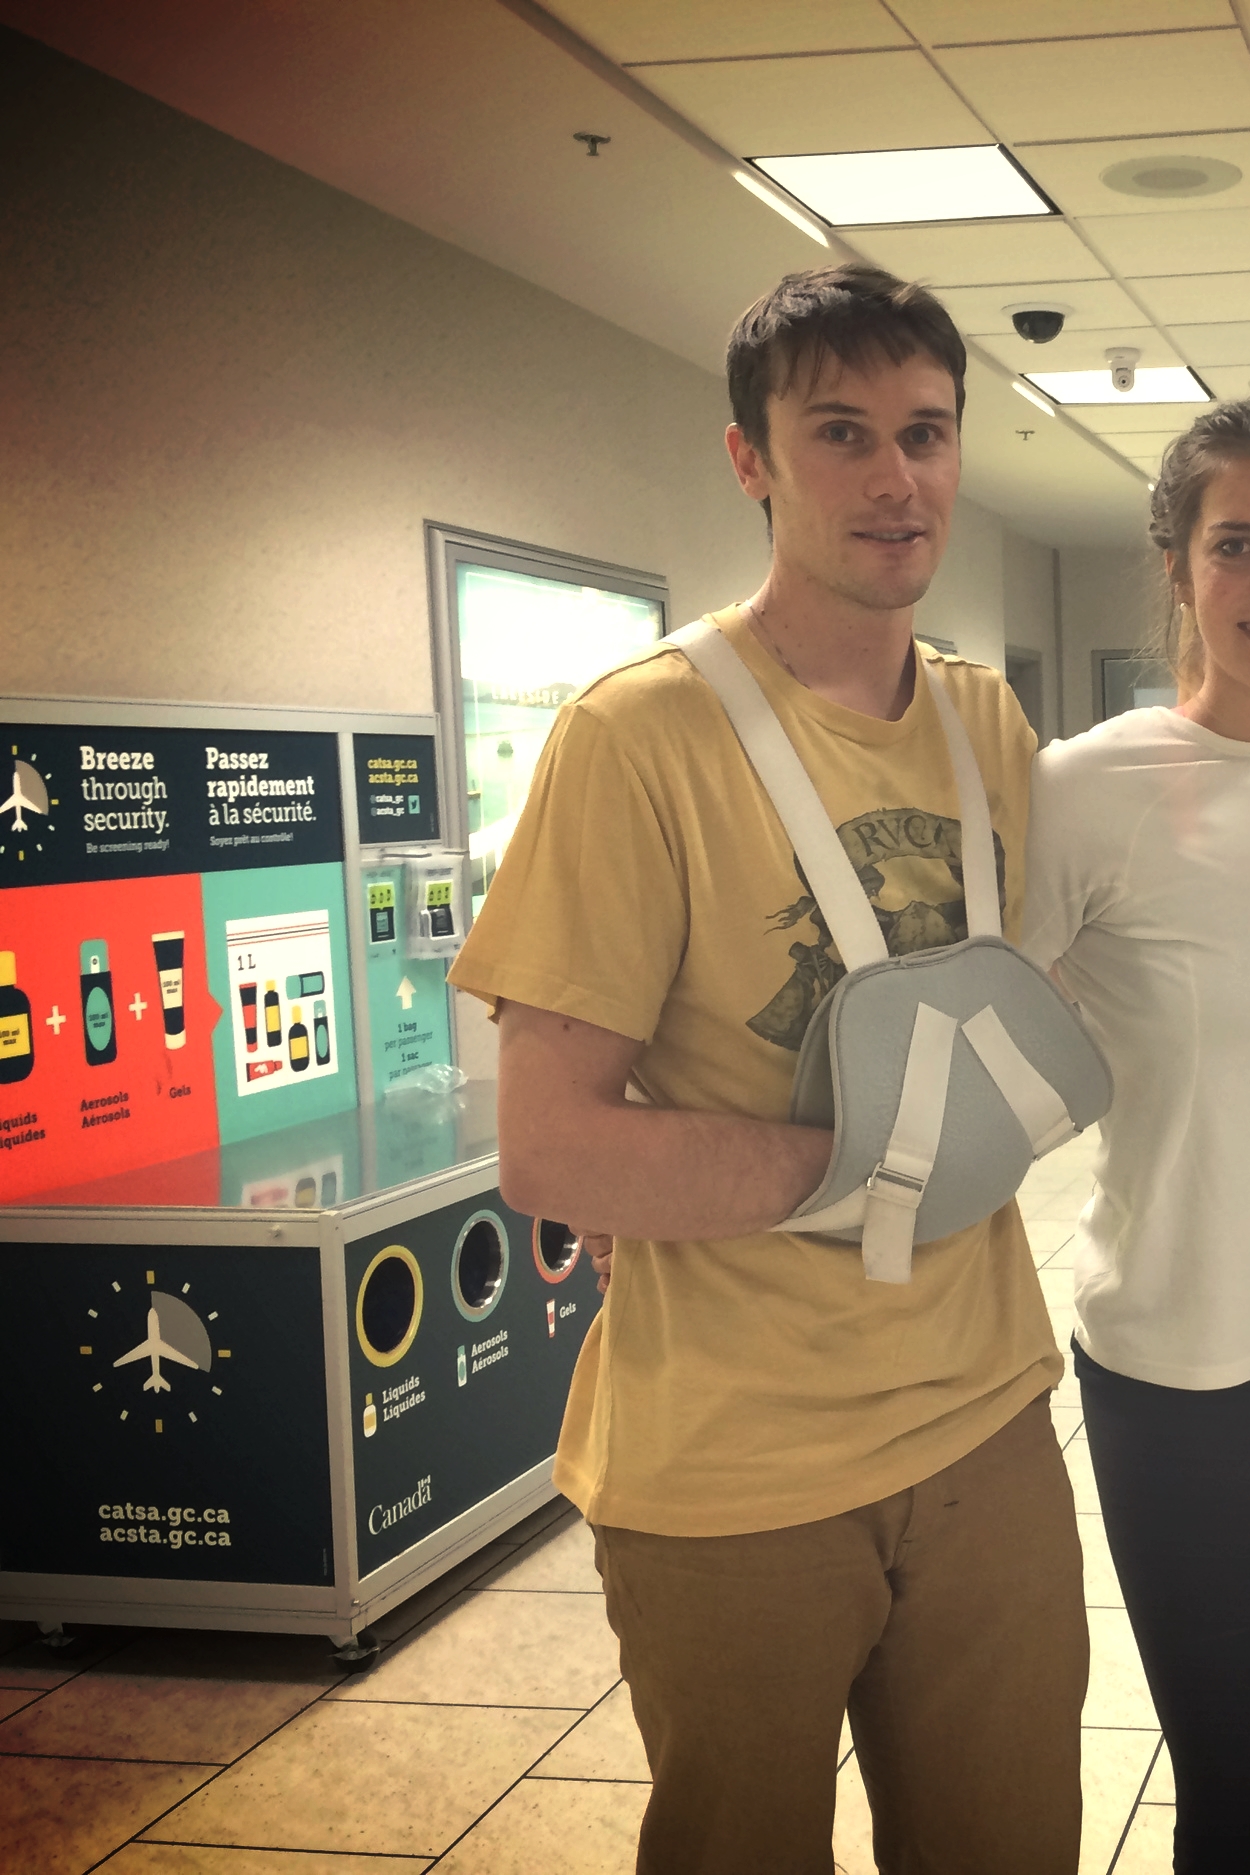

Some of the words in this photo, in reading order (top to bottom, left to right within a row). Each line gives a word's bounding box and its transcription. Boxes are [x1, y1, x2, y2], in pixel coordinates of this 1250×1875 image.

[79, 745, 155, 771] Breeze
[205, 747, 269, 770] Passez
[367, 757, 418, 773] catsa.gc.ca
[80, 775, 168, 806] through
[206, 775, 315, 803] rapidement
[368, 771, 419, 787] acsta.gc.ca
[83, 805, 170, 835] security.
[209, 803, 220, 826] à
[223, 803, 240, 826] la
[243, 800, 317, 825] sécurité.
[247, 953, 256, 969] L
[80, 1091, 129, 1112] Aerosols
[169, 1084, 191, 1099] Gels
[81, 1107, 131, 1129] Aérosols
[0, 1128, 46, 1151] iquides
[559, 1302, 577, 1319] Gels
[471, 1329, 509, 1358] Aerosols
[471, 1345, 509, 1375] Aérosols
[382, 1375, 420, 1405] Liquids
[383, 1390, 426, 1422] Liquides
[98, 1502, 231, 1527] catsa.gc.ca
[368, 1478, 432, 1536] Canada
[99, 1524, 232, 1550] acsta.gc.ca
